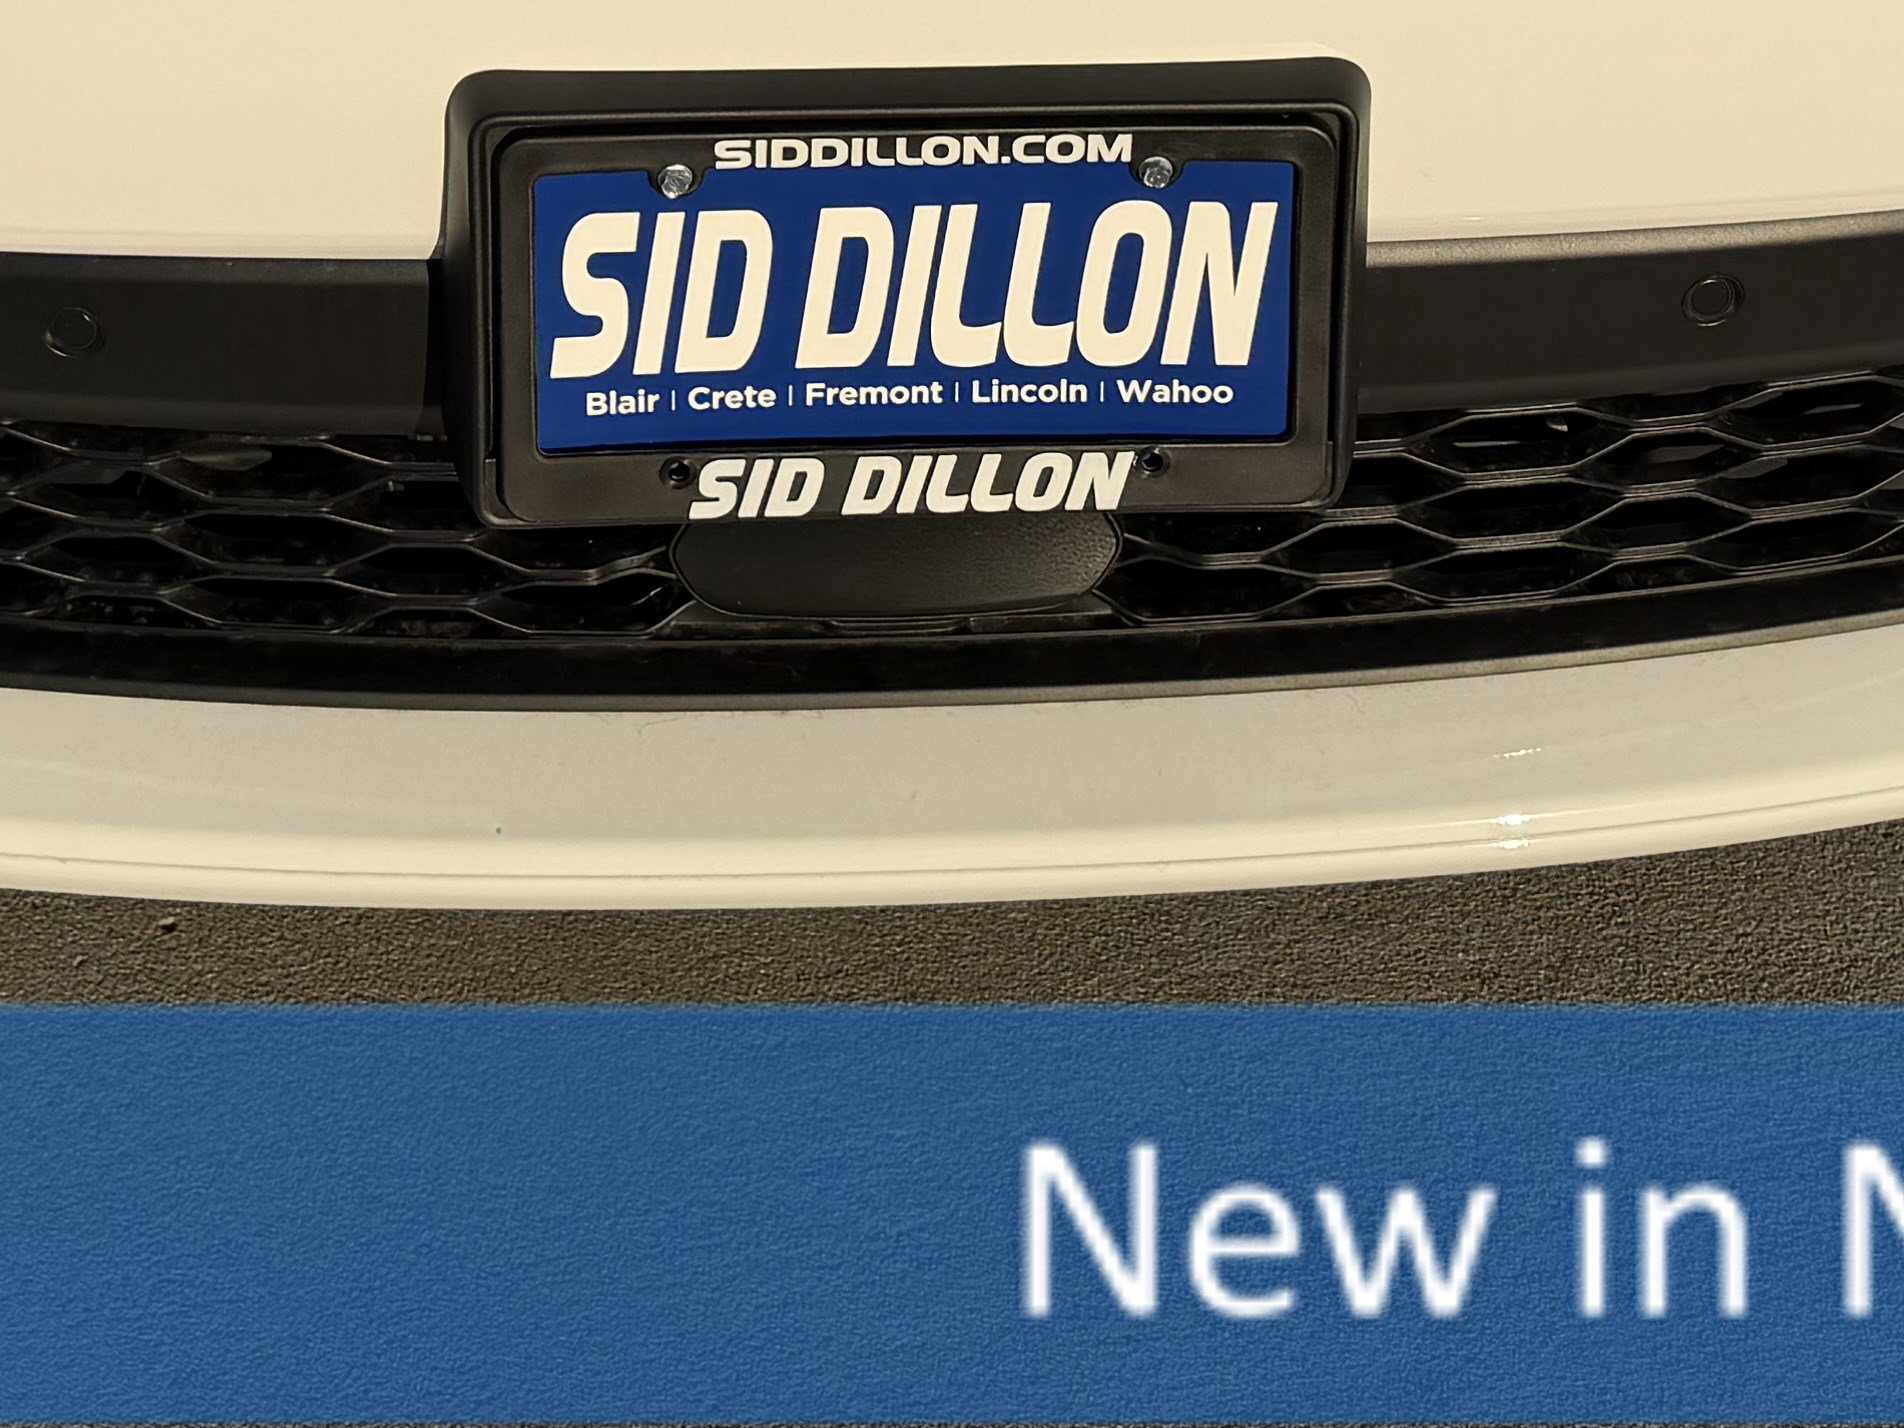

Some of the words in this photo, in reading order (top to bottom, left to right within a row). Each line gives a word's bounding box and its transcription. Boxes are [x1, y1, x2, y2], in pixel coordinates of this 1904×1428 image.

[714, 132, 1134, 170] SIDDILLON.COM
[549, 209, 774, 379] SID
[794, 199, 1279, 370] DILLON
[586, 388, 661, 416] Blair
[687, 385, 777, 411] Crete
[805, 381, 944, 407] Fremont
[971, 378, 1088, 404] Lincoln
[1116, 378, 1234, 405] Wahoo
[688, 457, 825, 520] SID
[841, 450, 1135, 516] DILLON
